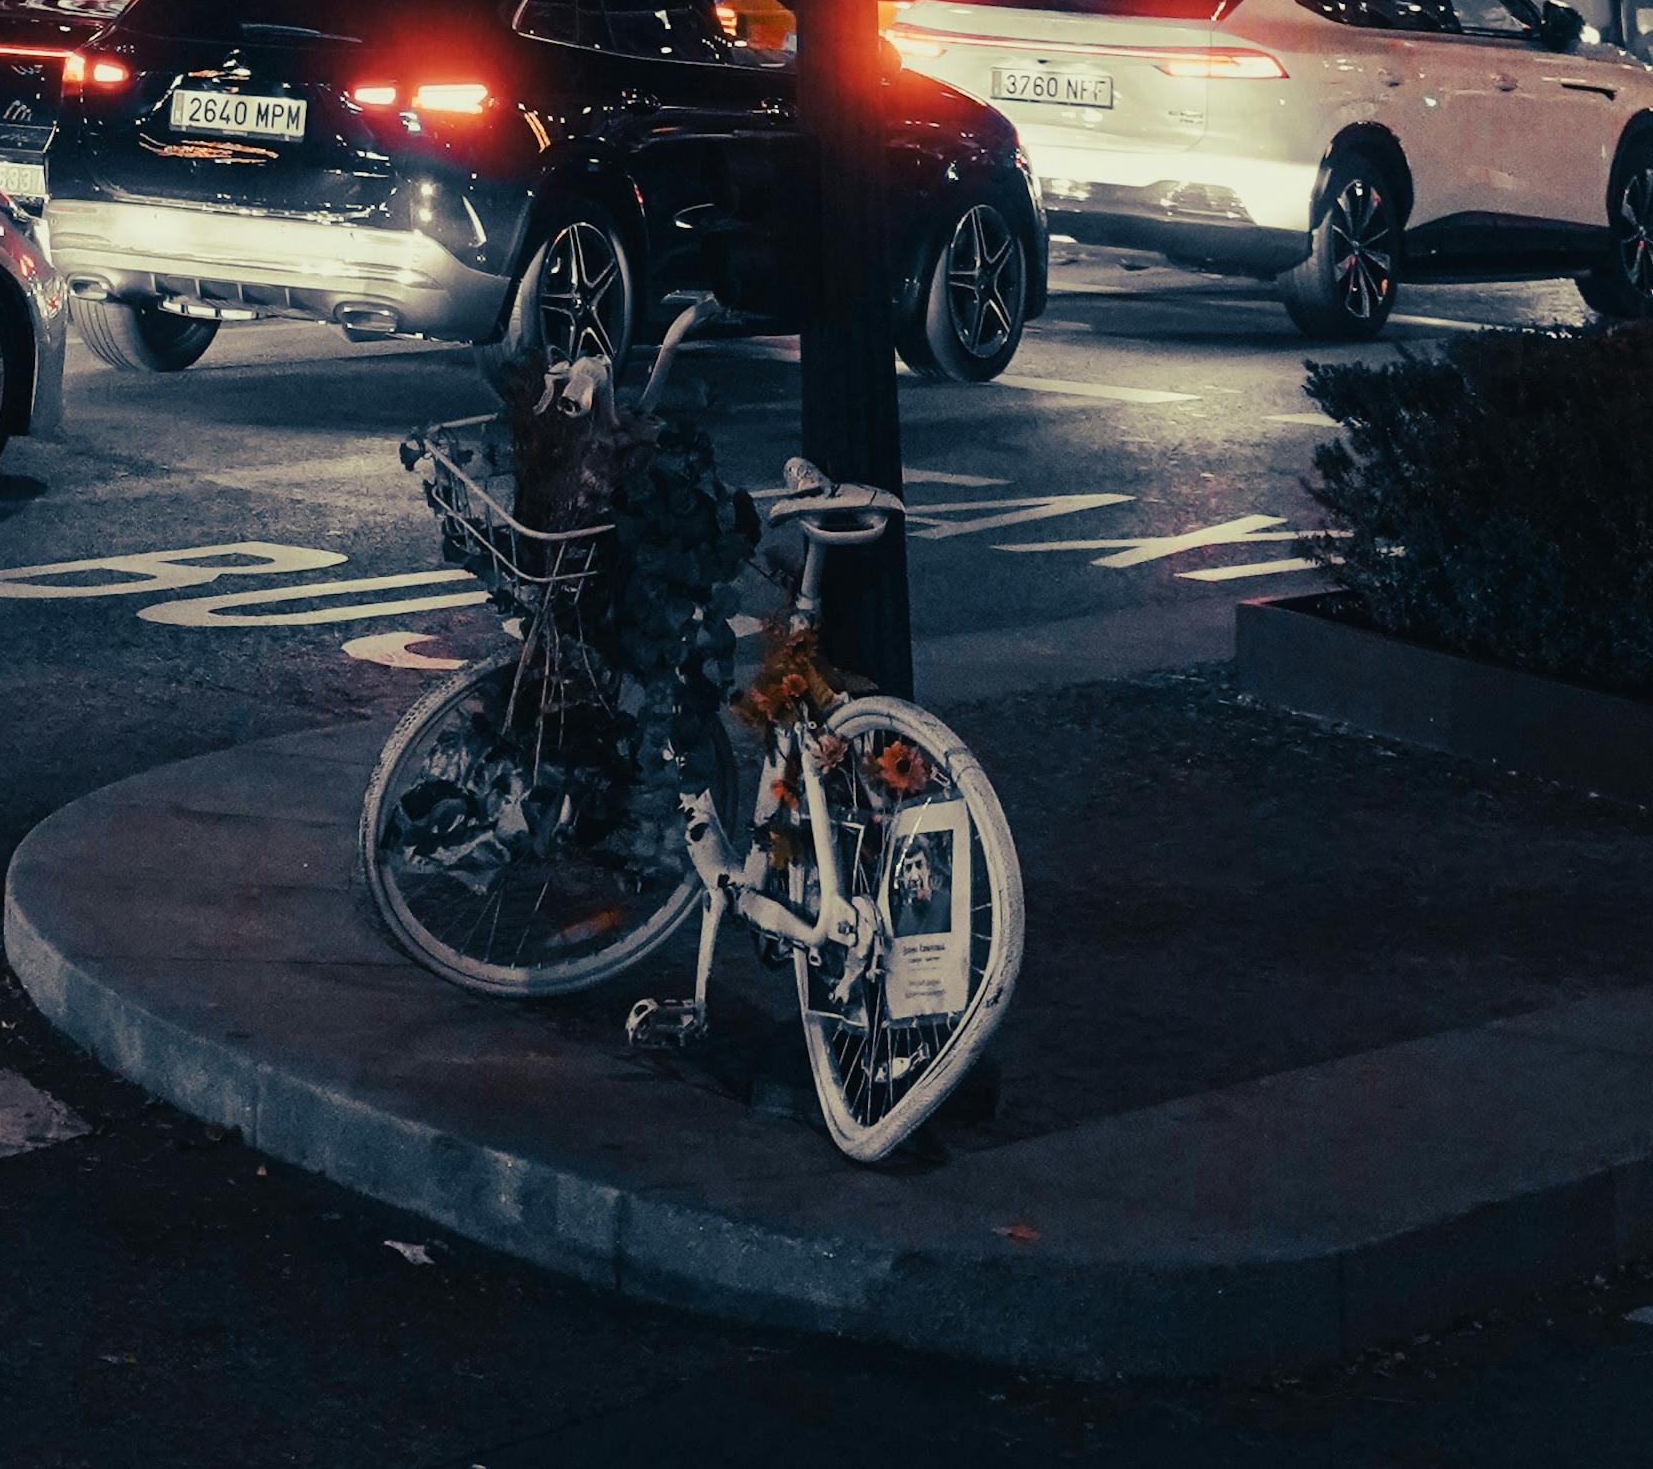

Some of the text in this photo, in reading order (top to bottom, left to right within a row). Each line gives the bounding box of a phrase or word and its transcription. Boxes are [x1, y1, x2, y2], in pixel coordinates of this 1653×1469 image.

[1006, 74, 1058, 98] 3760
[188, 97, 301, 130] 2640 MPM
